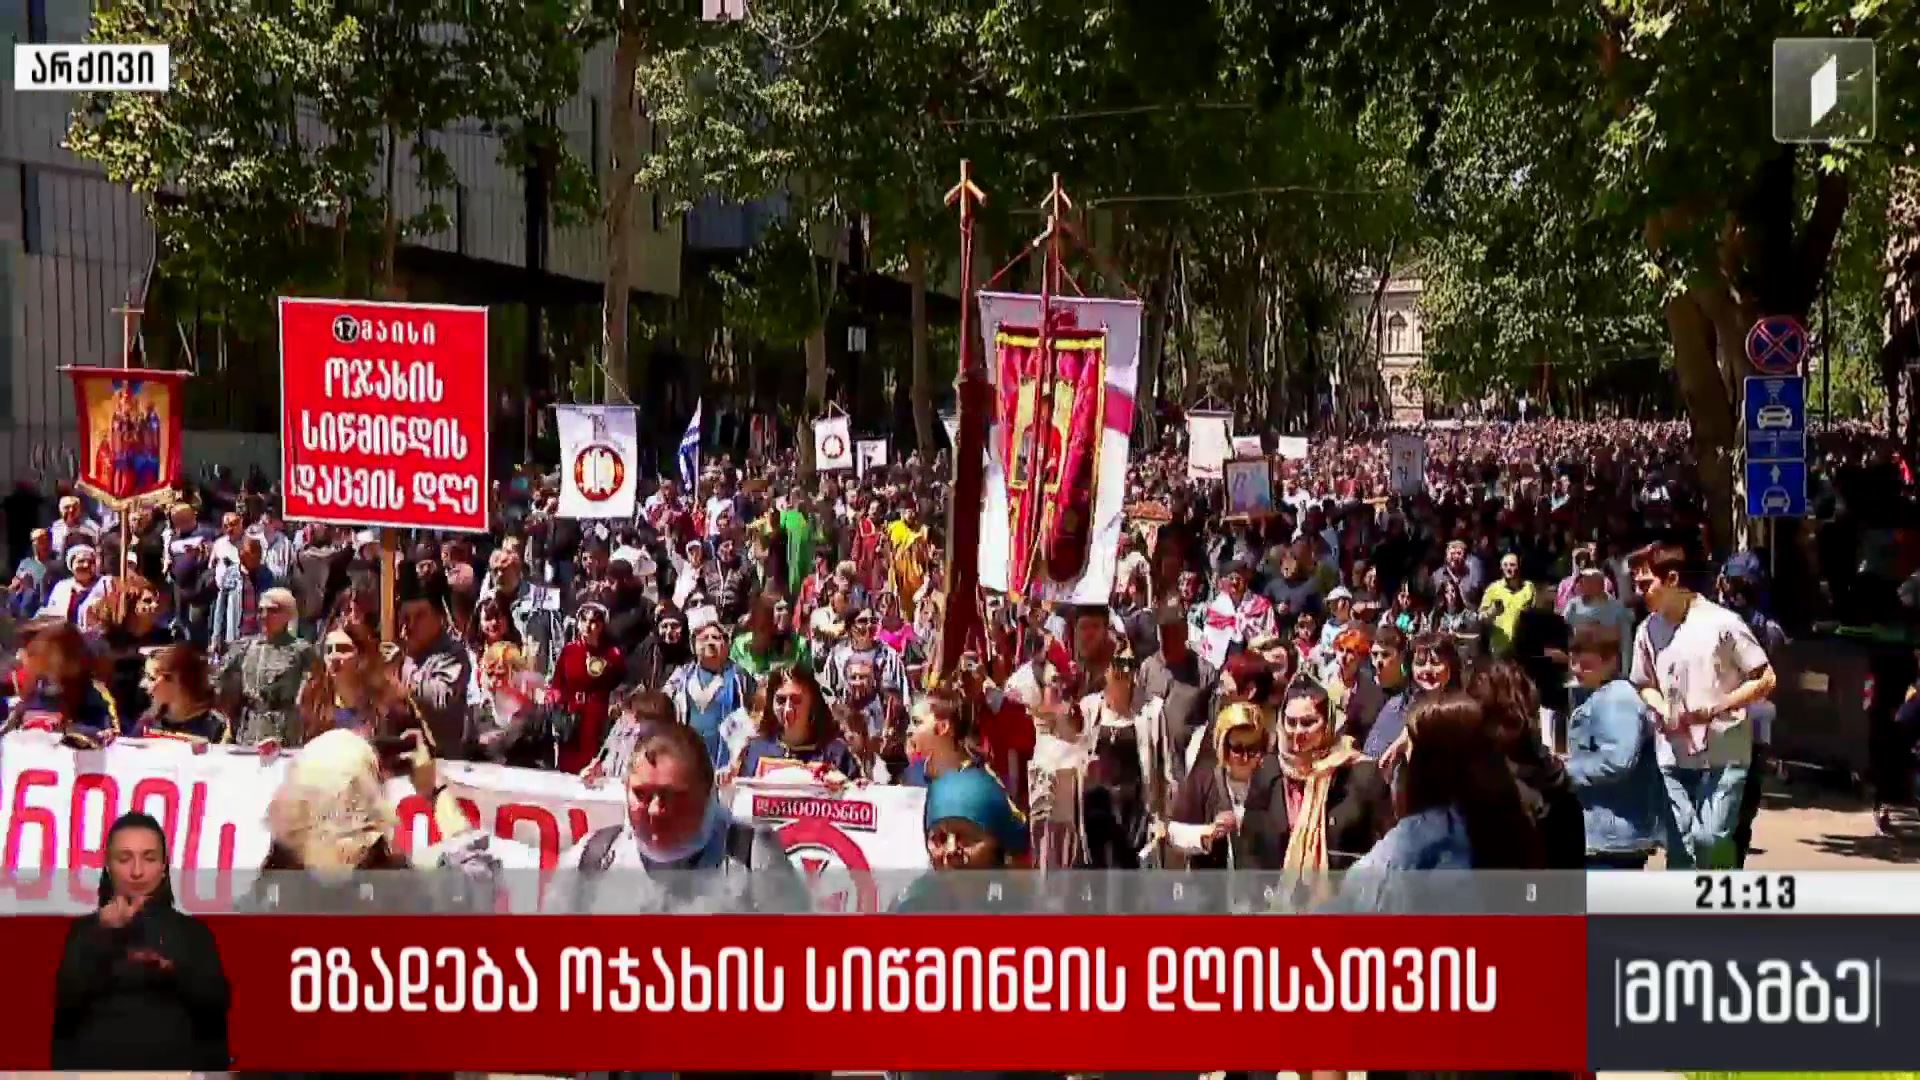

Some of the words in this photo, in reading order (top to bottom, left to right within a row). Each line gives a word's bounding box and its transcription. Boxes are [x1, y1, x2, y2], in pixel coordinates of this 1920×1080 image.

[335, 318, 357, 341] 17
[361, 318, 437, 345] მაისი
[324, 356, 444, 404] ოჯახის
[301, 408, 469, 461] სიწმინდის
[290, 463, 406, 510] დაცვის
[412, 470, 480, 516] დღე
